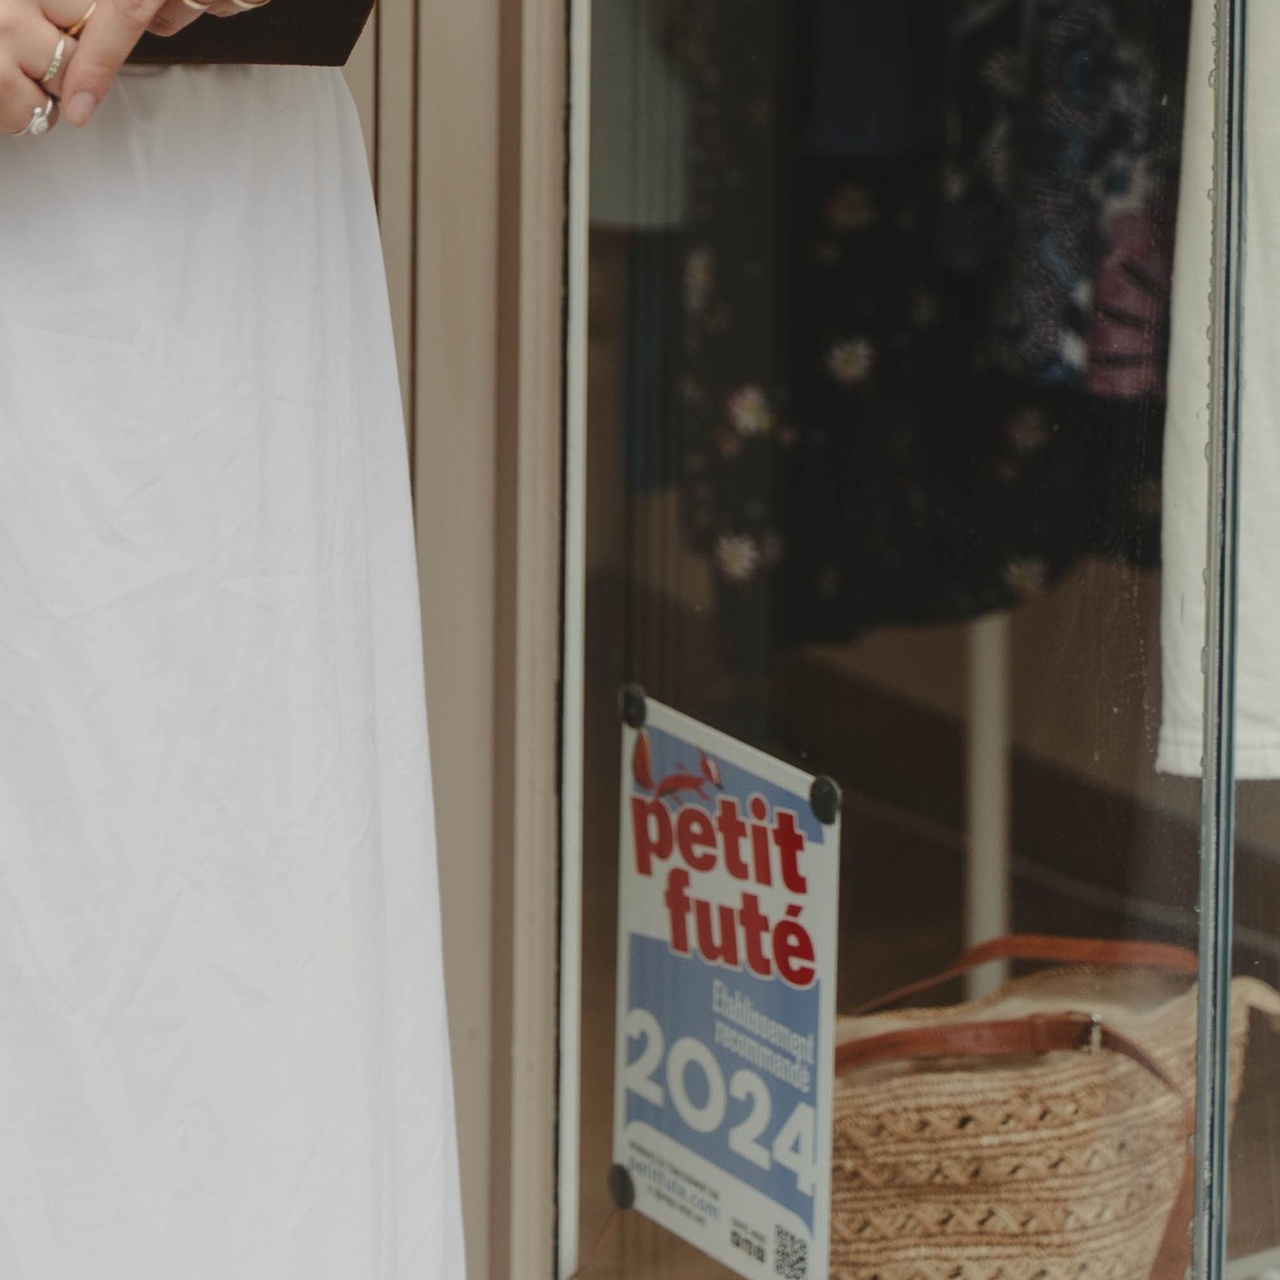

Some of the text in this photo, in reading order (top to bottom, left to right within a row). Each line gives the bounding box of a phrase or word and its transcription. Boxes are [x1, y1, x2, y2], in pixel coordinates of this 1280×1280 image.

[631, 796, 808, 894] petit
[665, 869, 815, 986] futé
[621, 1007, 817, 1198] 2024
